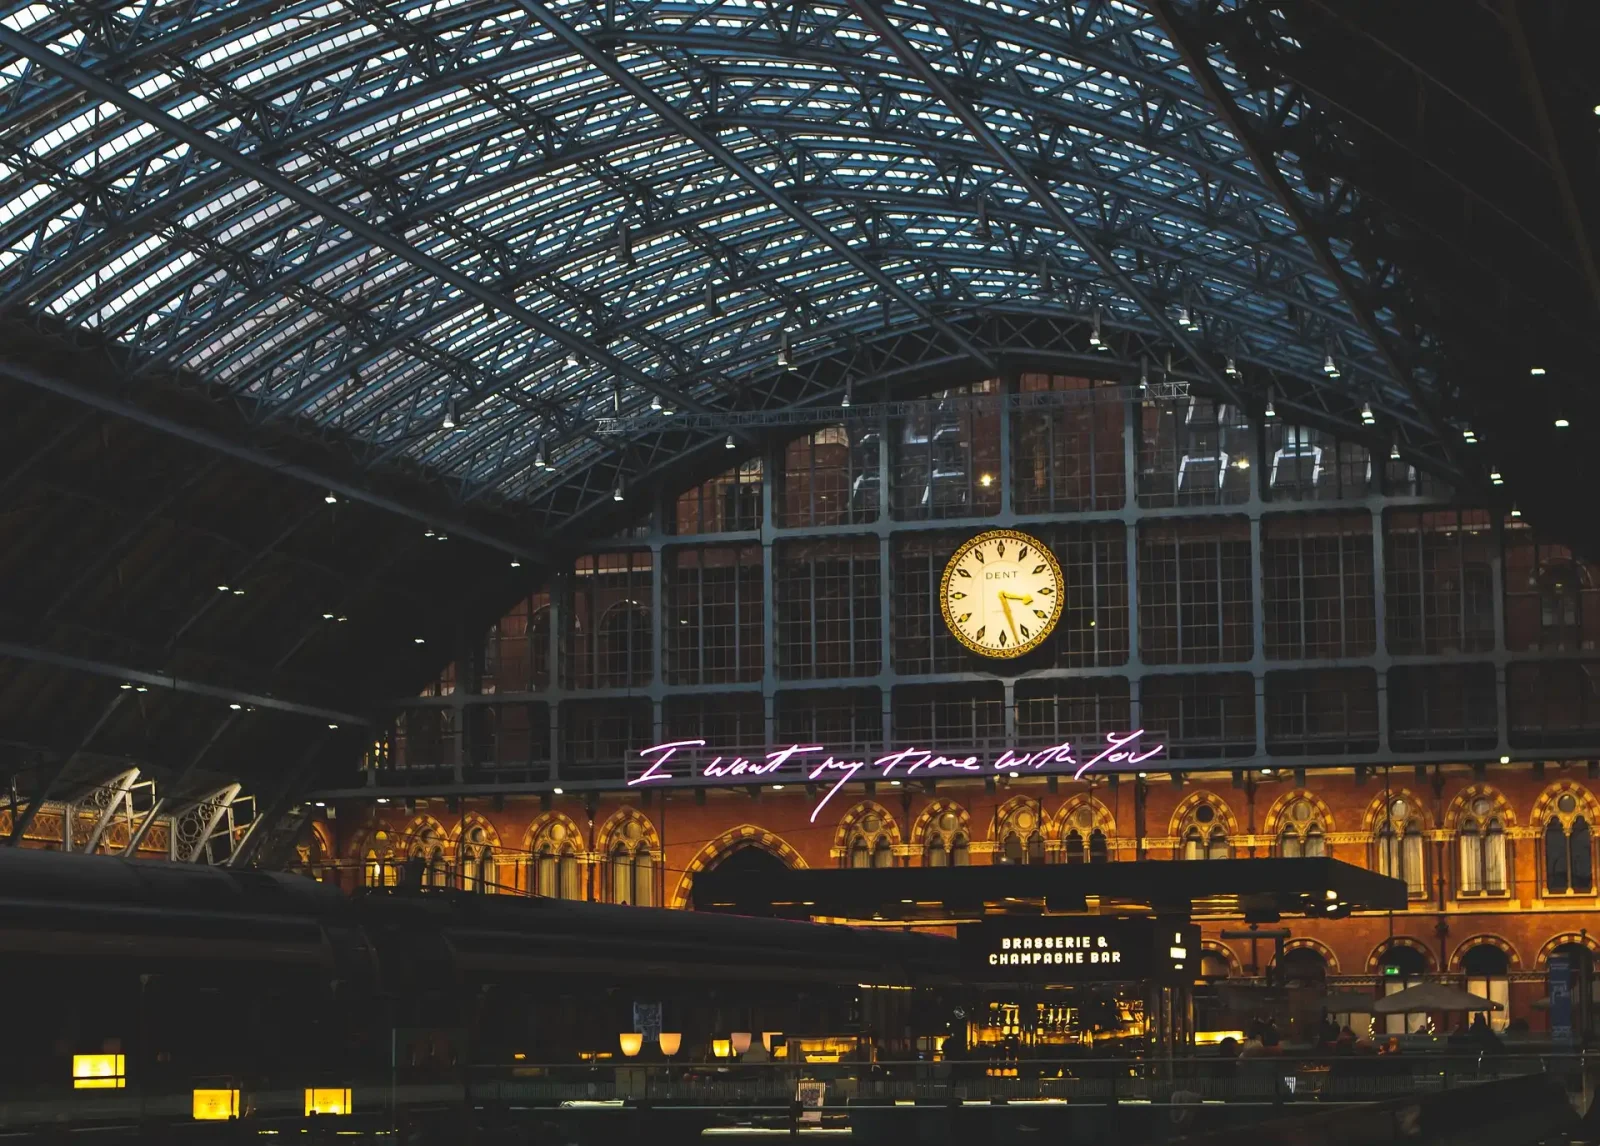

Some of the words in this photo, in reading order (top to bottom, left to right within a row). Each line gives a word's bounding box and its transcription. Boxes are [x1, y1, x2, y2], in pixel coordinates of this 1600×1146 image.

[985, 571, 1018, 580] DENT
[628, 740, 706, 786] I
[1073, 729, 1164, 781] You
[1002, 936, 1091, 949] BRASSERIE
[1097, 936, 1108, 948] &
[989, 953, 1084, 965] CHAMPAGNE
[1090, 951, 1121, 964] BAR
